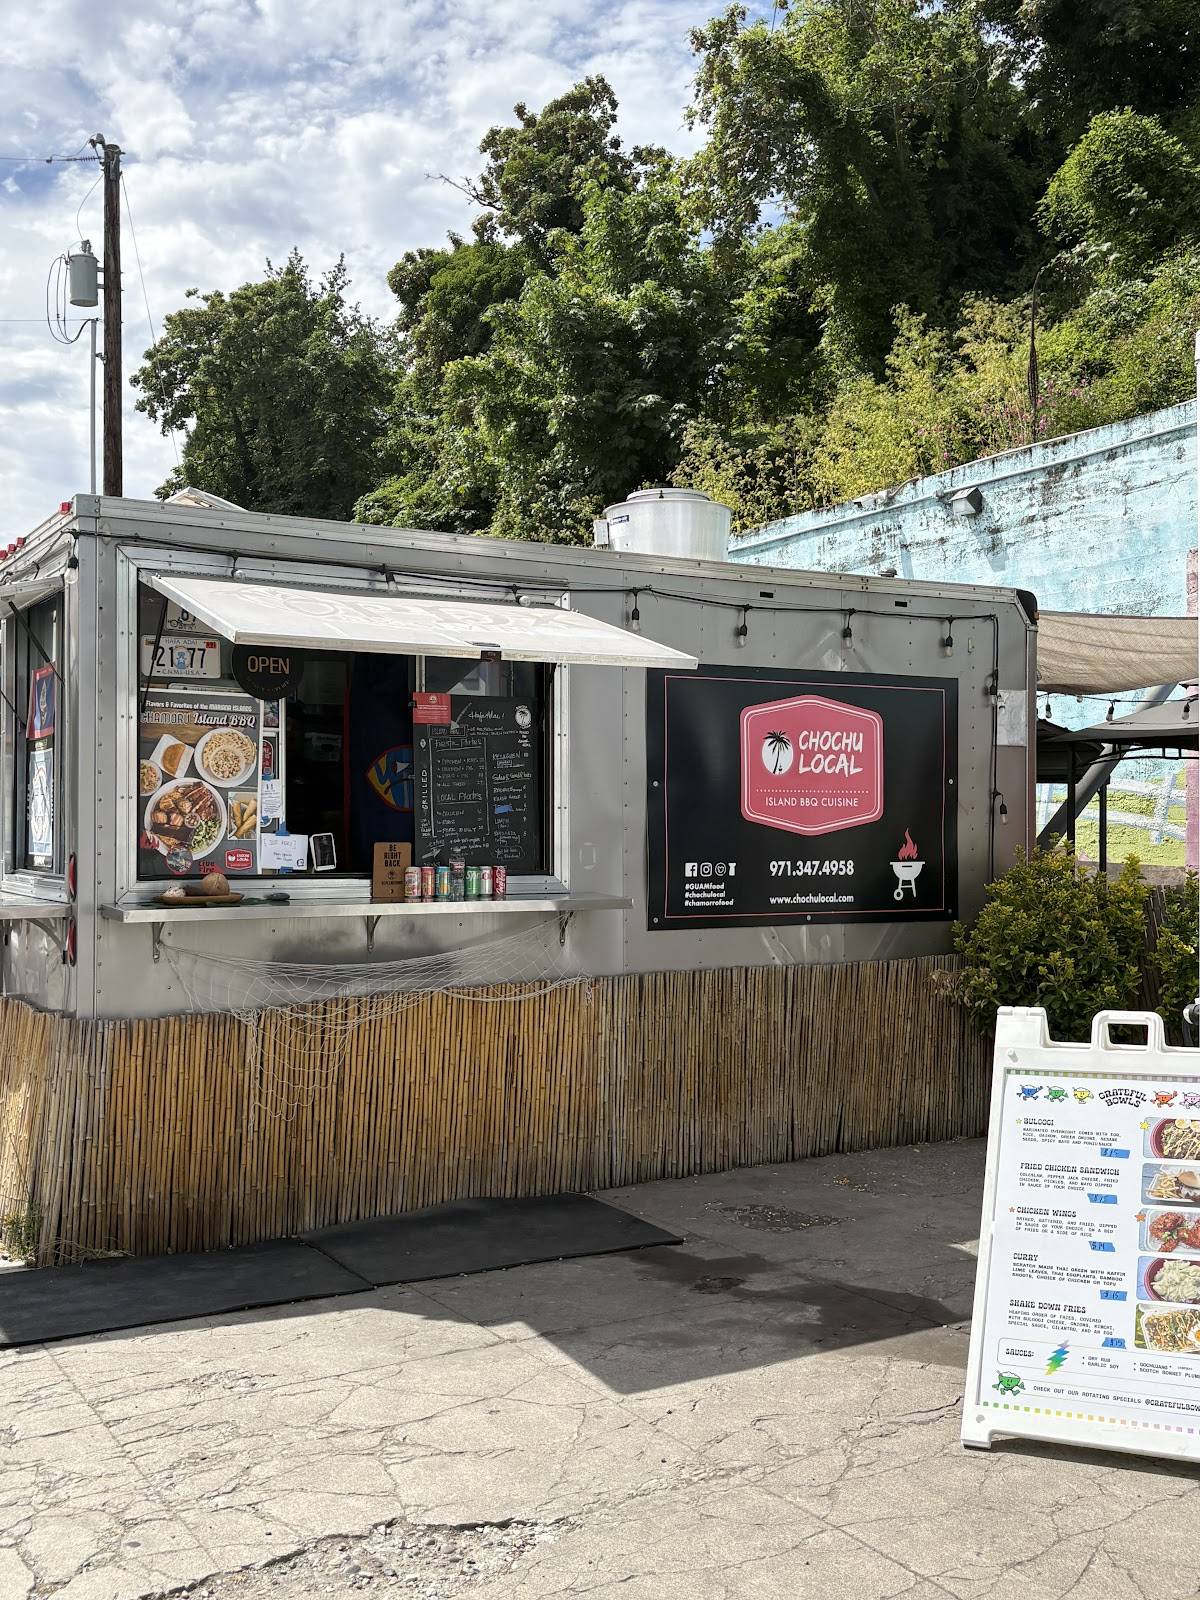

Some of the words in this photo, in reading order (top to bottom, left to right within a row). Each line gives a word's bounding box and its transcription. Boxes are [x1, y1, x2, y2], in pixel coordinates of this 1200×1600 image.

[247, 656, 290, 675] OPEN
[193, 712, 228, 726] Island
[228, 713, 257, 728] BBQ
[799, 730, 864, 752] CHOCHU
[798, 754, 864, 778] LOCAL
[766, 796, 797, 807] ISLAND
[800, 798, 818, 807] BBQ
[821, 798, 858, 807] CUISINE
[388, 844, 397, 852] BE
[384, 852, 402, 860] RIGHT
[770, 860, 854, 877] 971.347.4958
[685, 882, 724, 890] #GUAMfood
[685, 899, 734, 907] #chamorrofood
[770, 892, 854, 904] www.chochulocal.com
[1098, 1088, 1147, 1102] GRATEFUL
[1105, 1096, 1141, 1108] BOWLS
[1045, 1164, 1077, 1173] CHICKEN
[1080, 1167, 1120, 1176] SANDWICH
[1017, 1207, 1049, 1216] CHICKEN
[1052, 1209, 1077, 1218] WINGS
[1013, 1253, 1038, 1262] CURRY
[1009, 1299, 1036, 1309] SHAKE
[1038, 1302, 1061, 1311] DOWN
[1063, 1305, 1086, 1313] FRIES
[1005, 1348, 1035, 1358] SAUCES:
[1082, 1391, 1110, 1400] ROTATING
